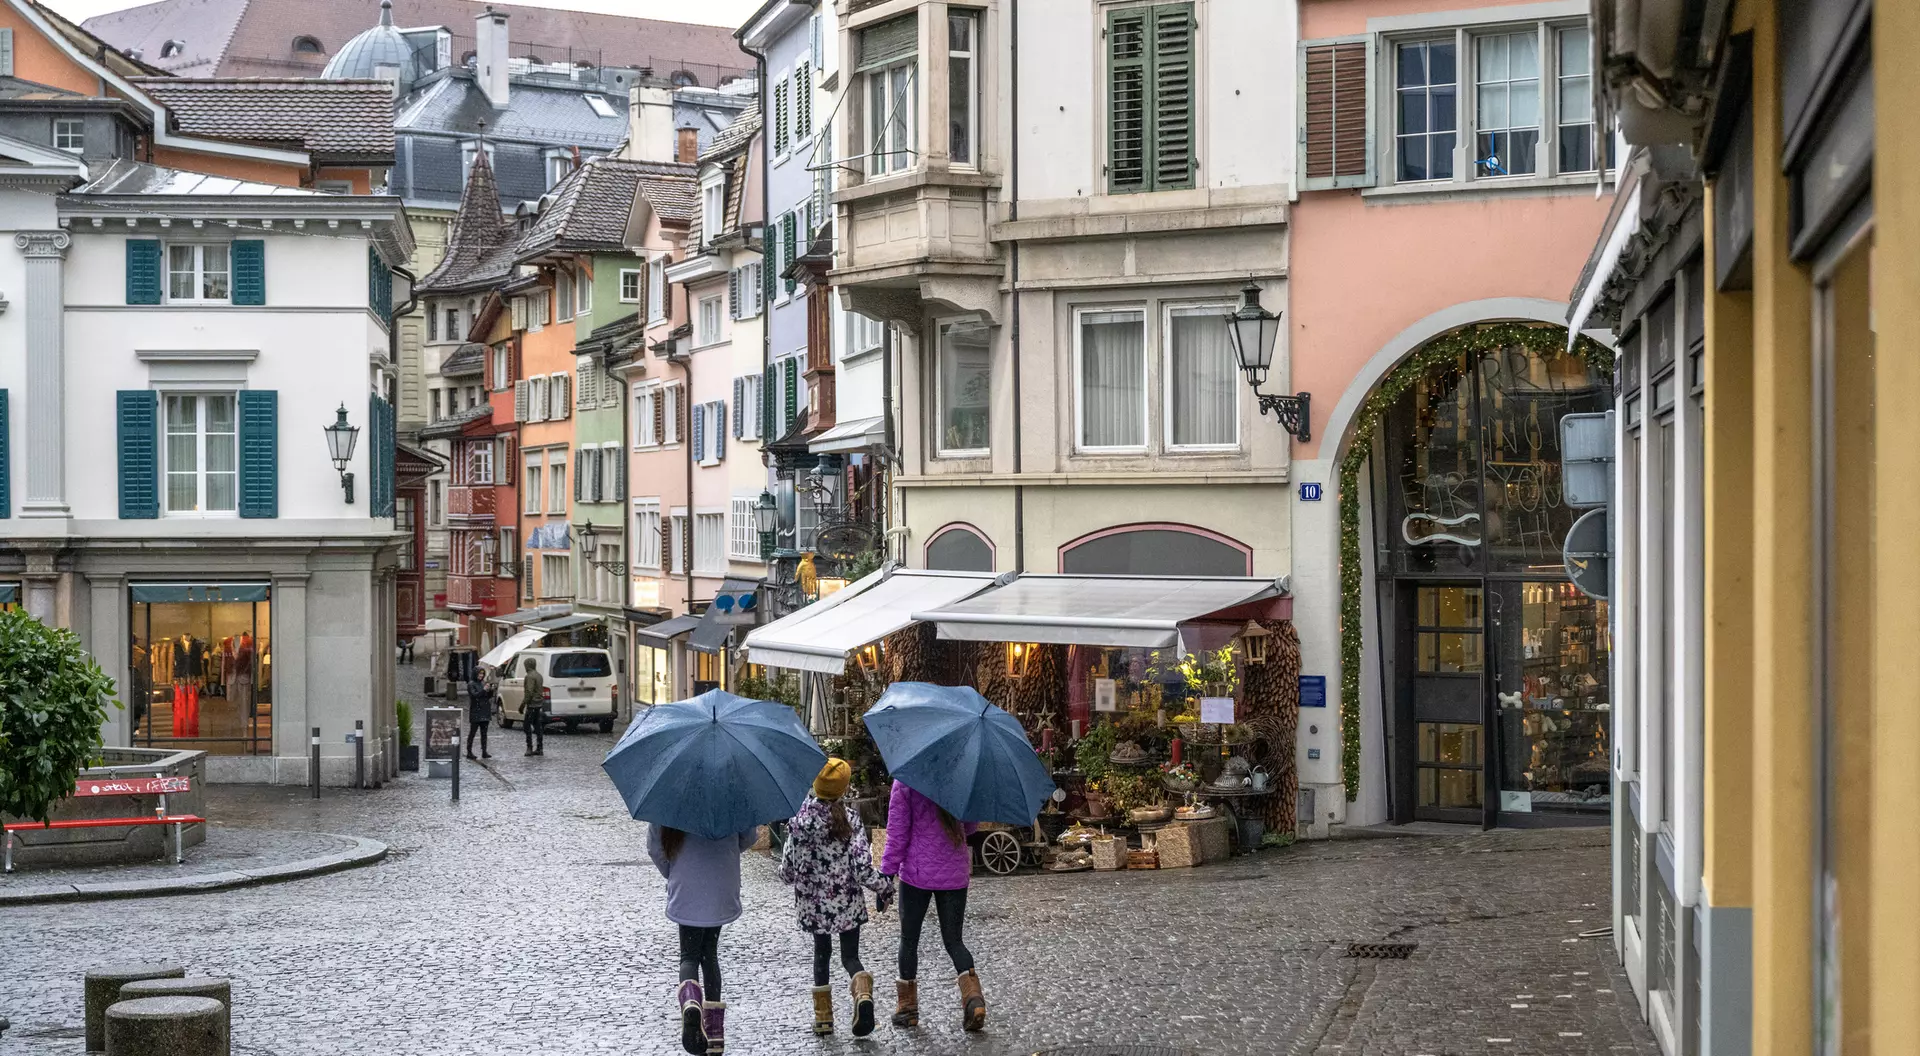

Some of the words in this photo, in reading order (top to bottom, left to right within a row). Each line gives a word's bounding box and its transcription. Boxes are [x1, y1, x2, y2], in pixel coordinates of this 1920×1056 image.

[1488, 403, 1566, 460] NOT
[1305, 485, 1316, 498] 10
[1400, 471, 1476, 520] FOR
[1486, 461, 1563, 512] YOU
